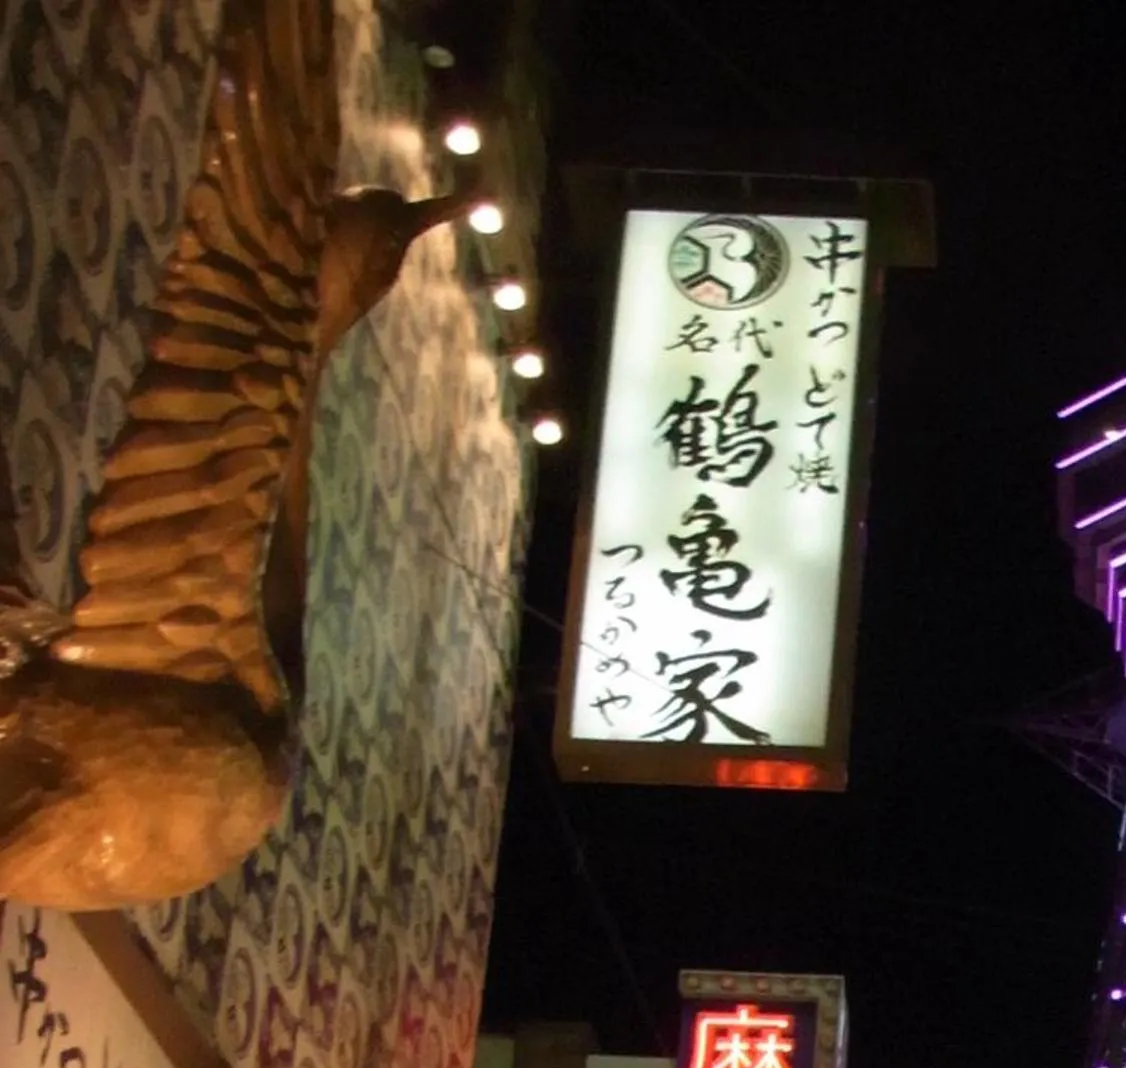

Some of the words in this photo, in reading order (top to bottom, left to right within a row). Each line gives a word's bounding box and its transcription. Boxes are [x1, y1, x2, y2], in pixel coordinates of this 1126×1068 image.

[664, 314, 784, 360] 名代
[589, 543, 643, 727] つるかめや
[637, 362, 778, 747] 鶴亀家
